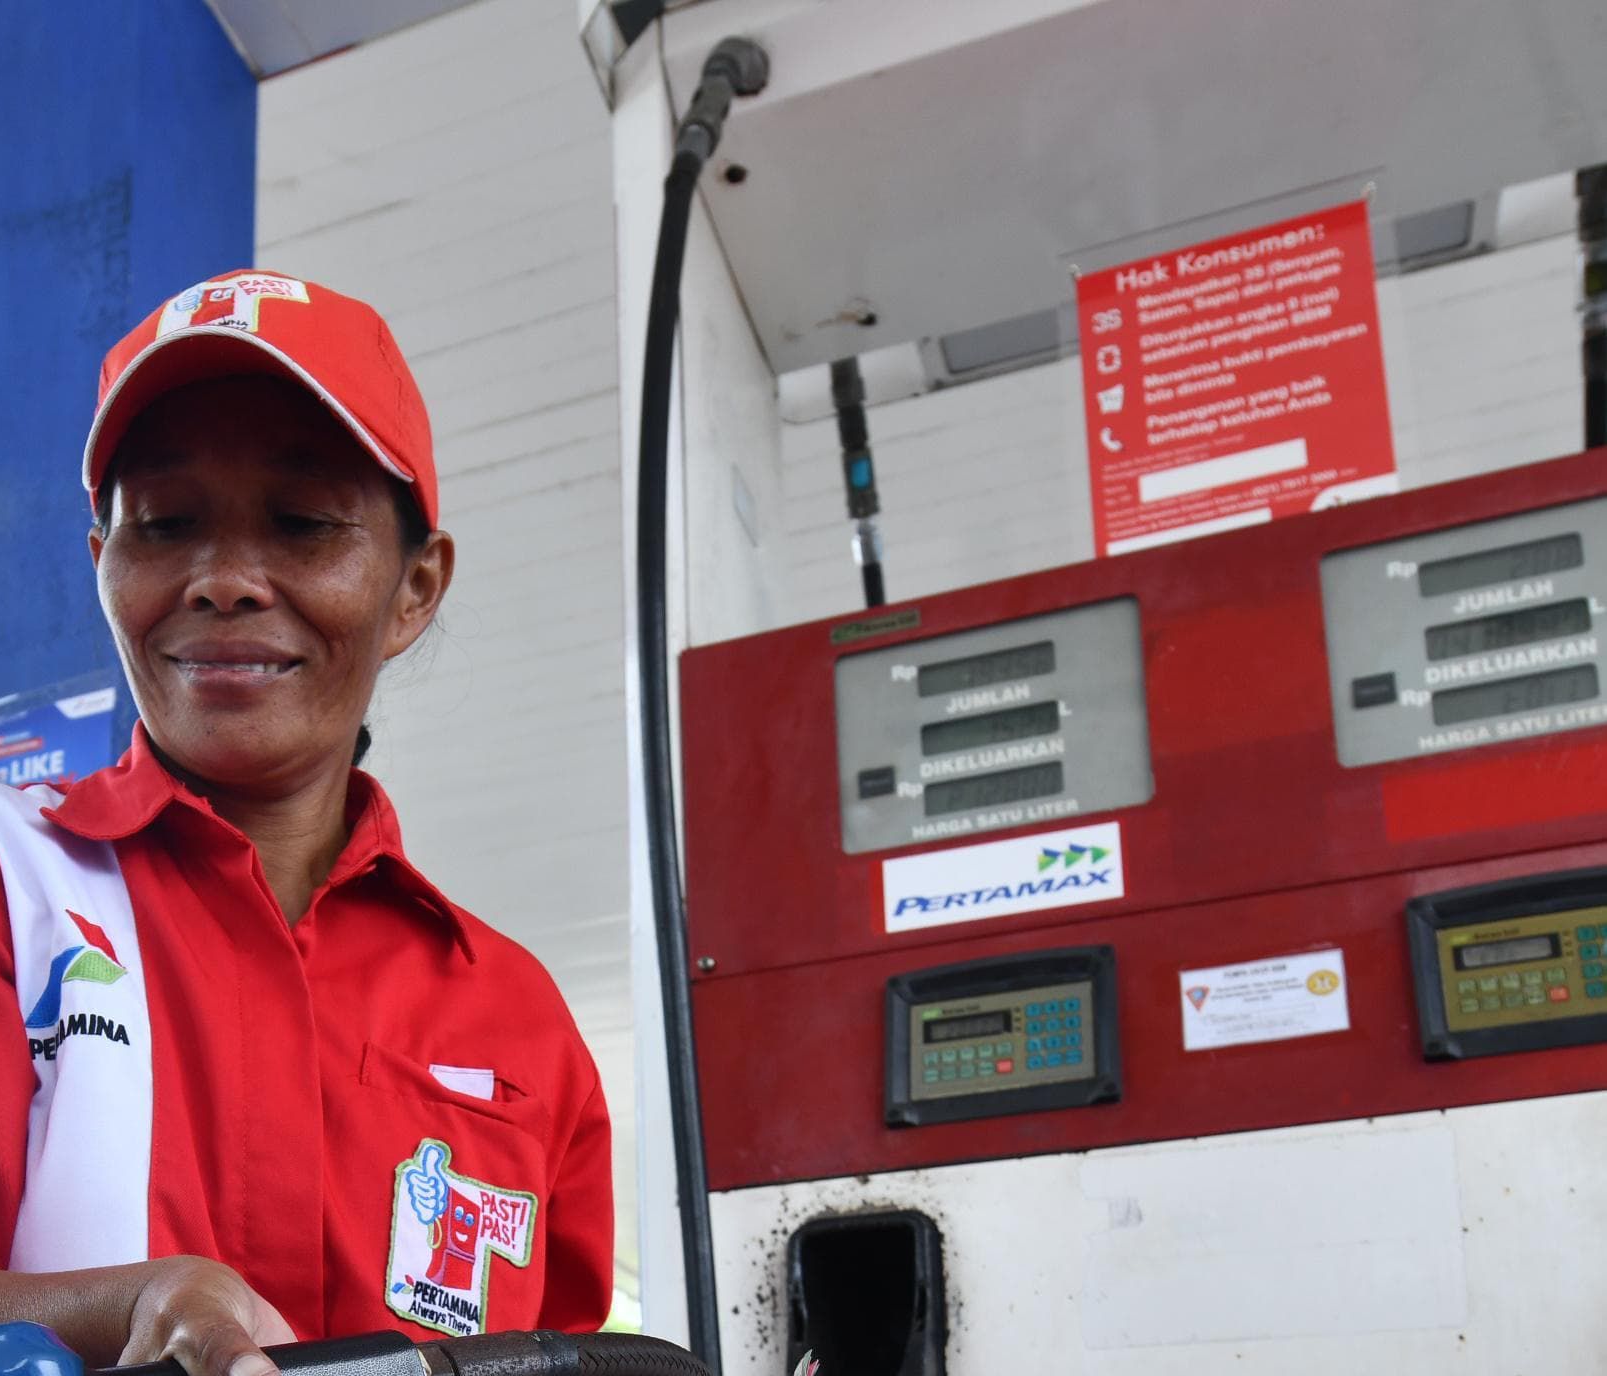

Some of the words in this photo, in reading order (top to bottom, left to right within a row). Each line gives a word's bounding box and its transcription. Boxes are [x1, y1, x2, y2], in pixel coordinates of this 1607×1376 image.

[1115, 261, 1170, 293] Hak
[1176, 223, 1325, 277] Konsumen:
[1453, 579, 1554, 615] JUMLAH
[1424, 638, 1598, 684] DIKELUARKAN
[945, 684, 1031, 714] JUMLAH
[1417, 725, 1492, 749] HARGA
[1497, 715, 1551, 737] SATU
[9, 749, 65, 783] LIKE
[919, 738, 1065, 778] DIKELUARKAN
[911, 817, 972, 840] HARGA
[977, 809, 1023, 829] SATU
[1026, 799, 1079, 821] LITER
[893, 868, 1113, 918] PERTAMAX
[479, 1191, 528, 1226] PASTI
[481, 1214, 517, 1250] PAS!
[408, 1301, 447, 1327] Always
[447, 1311, 472, 1335] There
[413, 1280, 479, 1322] PERTAMINA
